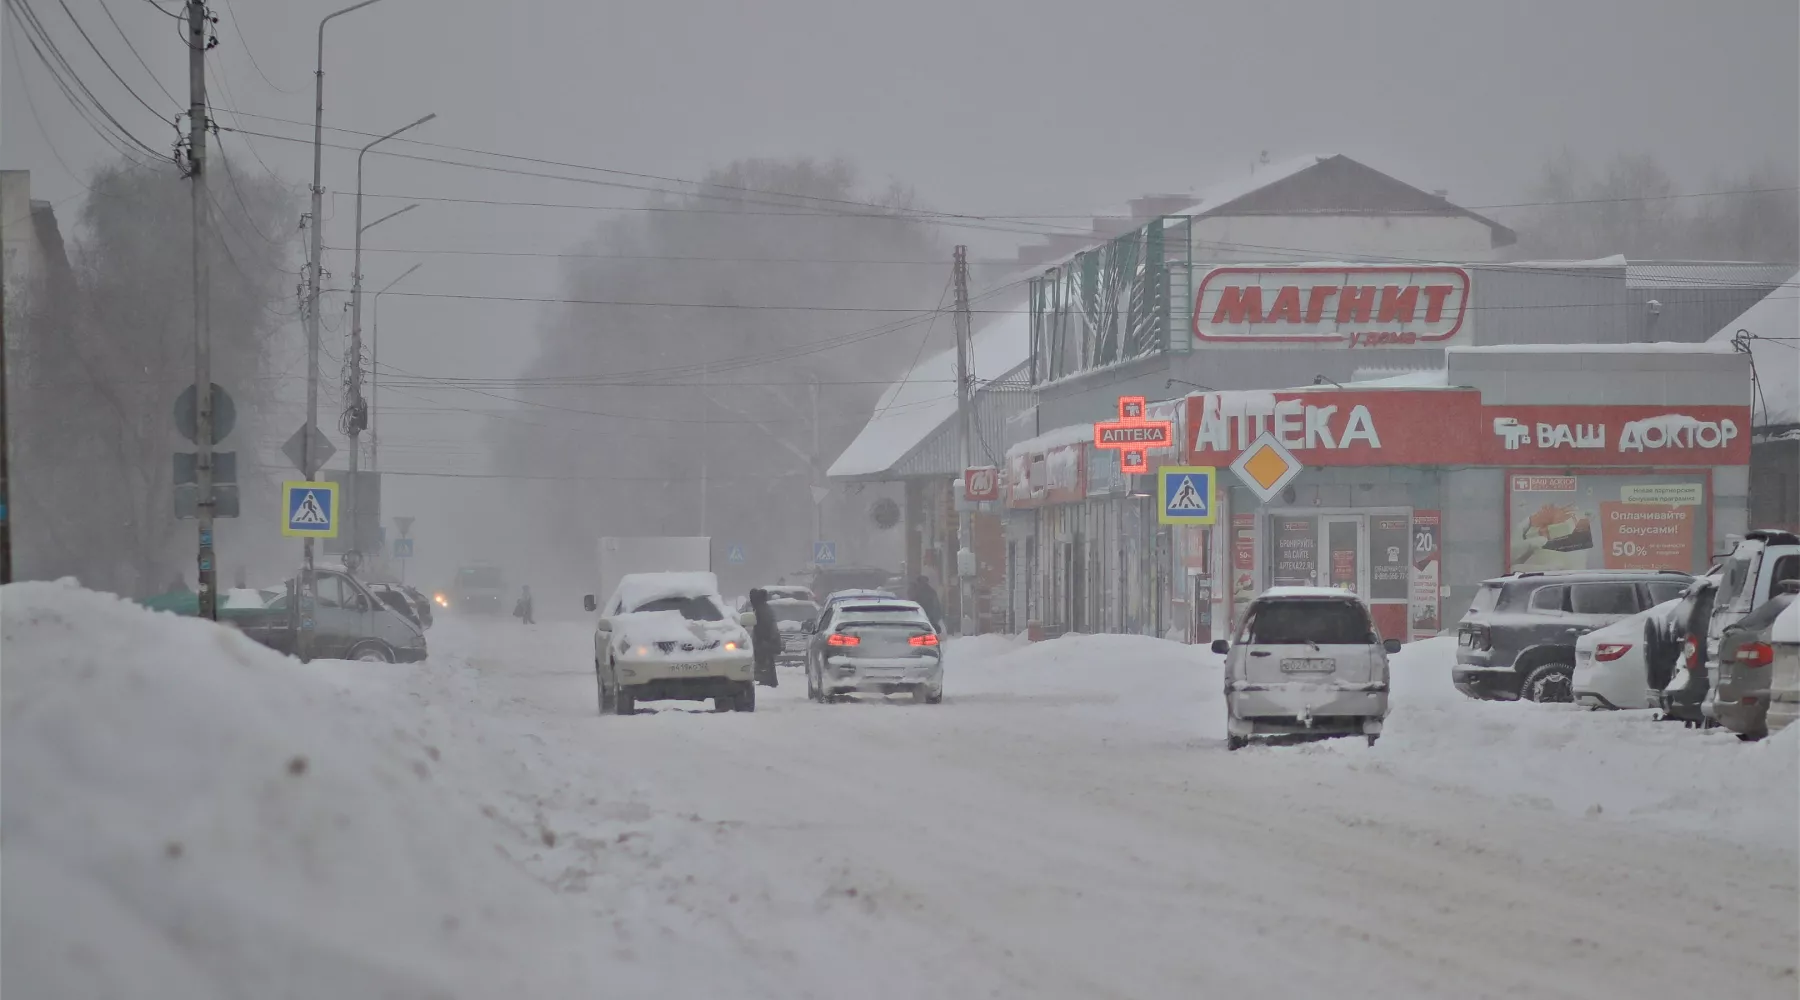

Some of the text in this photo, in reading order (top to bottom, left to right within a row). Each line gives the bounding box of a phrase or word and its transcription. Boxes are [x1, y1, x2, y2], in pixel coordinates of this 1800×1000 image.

[1210, 284, 1454, 324] МАГНИТ
[1194, 399, 1382, 452] АПТЕКА
[1103, 428, 1163, 442] АПТЕКА
[1536, 417, 1738, 452] ВАШ ДОКТОР
[1610, 510, 1686, 521] Оплачивайте
[1619, 524, 1678, 536] бонусами!
[1292, 548, 1310, 559] САЙТЕ
[1612, 541, 1647, 557] 50%
